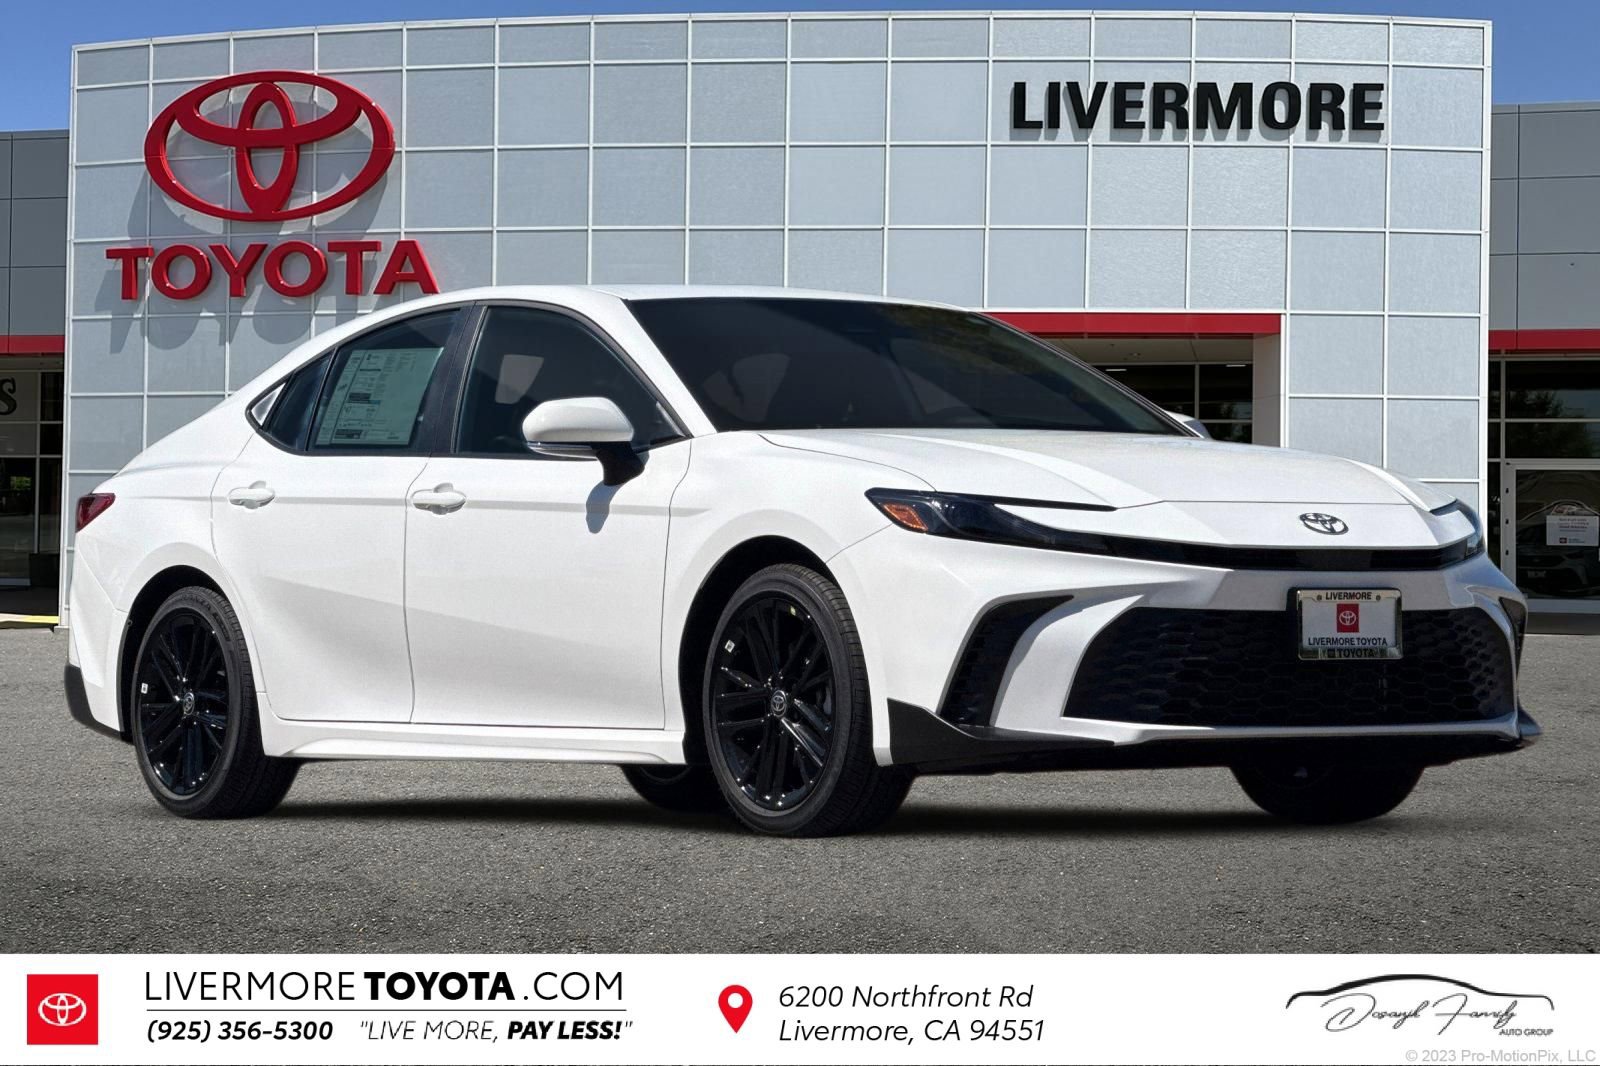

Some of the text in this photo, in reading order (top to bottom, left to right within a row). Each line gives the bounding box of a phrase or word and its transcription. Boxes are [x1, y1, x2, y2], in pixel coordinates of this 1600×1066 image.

[1012, 81, 1385, 131] LIVERMORE
[105, 239, 440, 301] TOYOTA
[1325, 591, 1372, 600] LIVERMORE
[1308, 637, 1387, 646] LIVERMORE TOYOTA
[1337, 648, 1375, 658] TOYOTA
